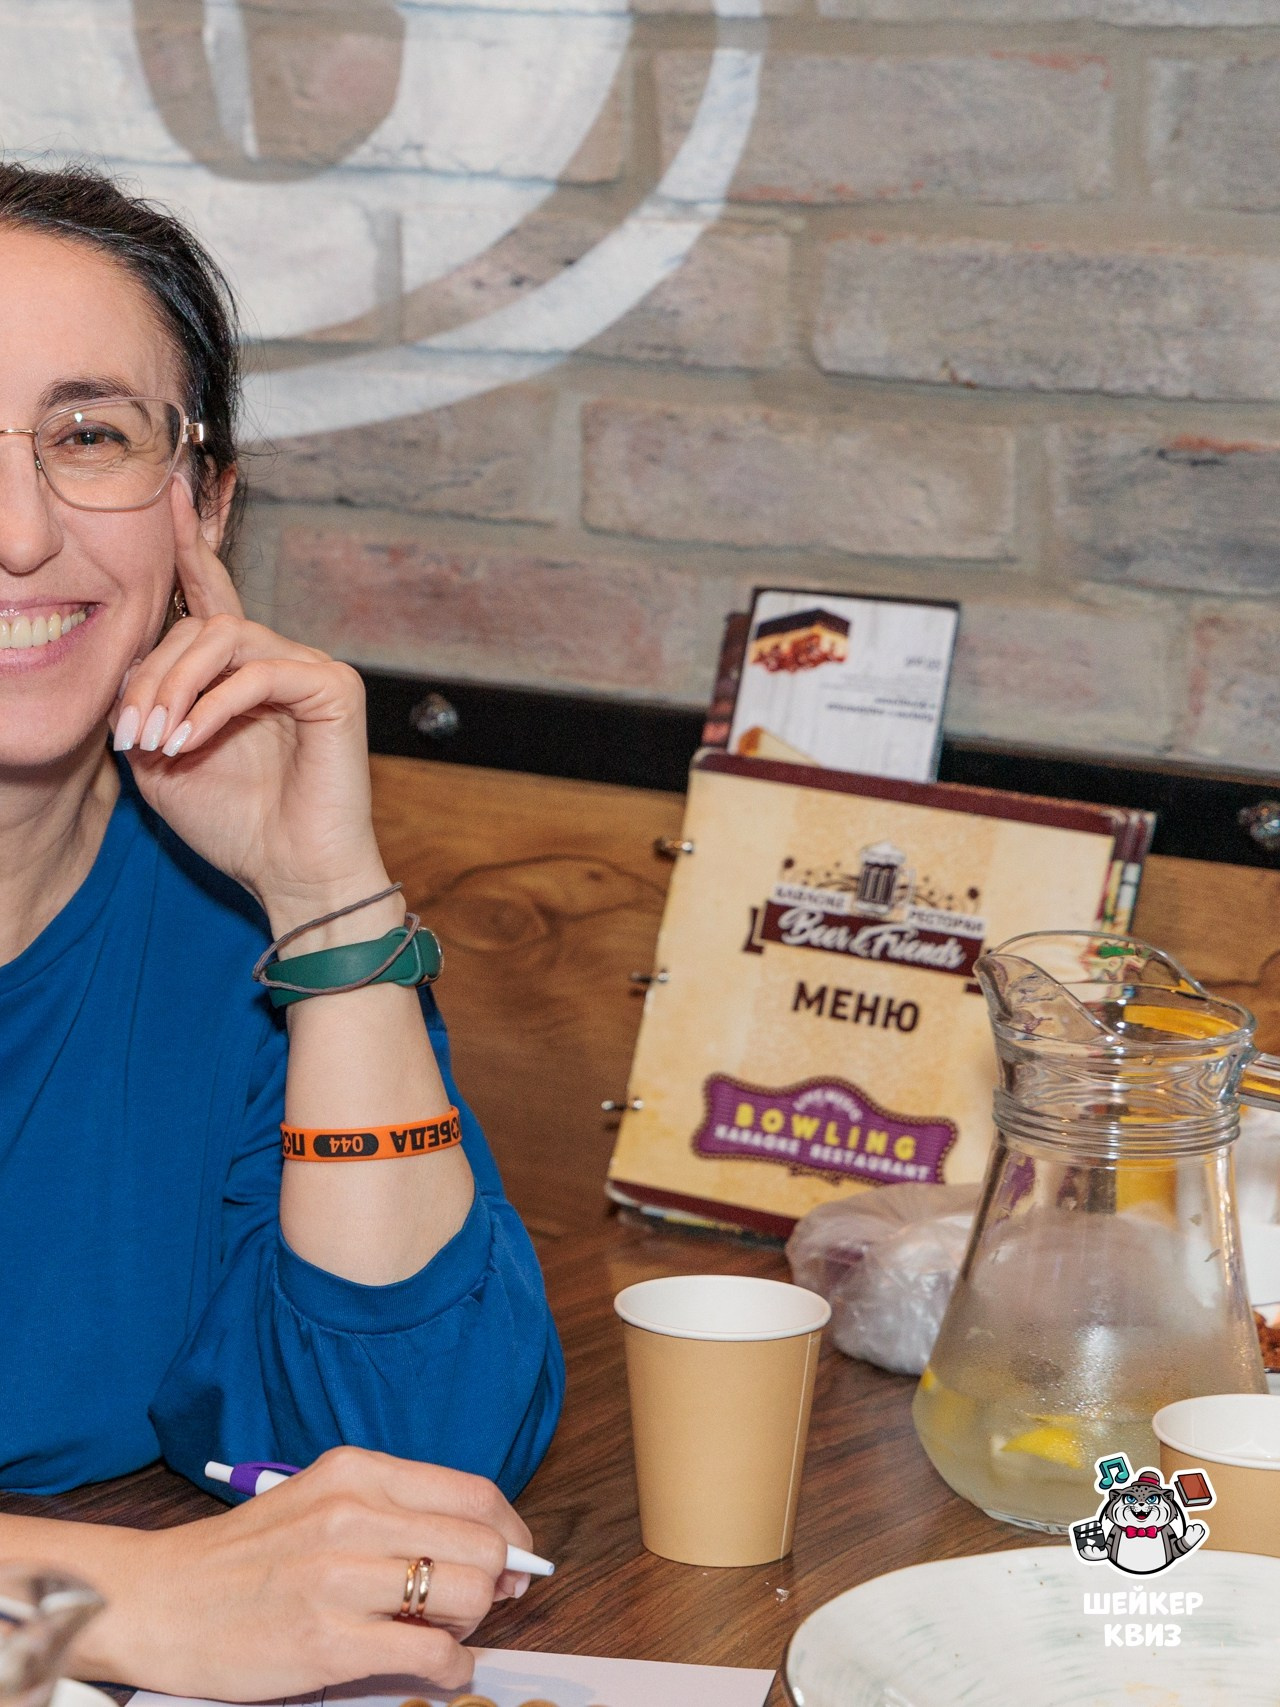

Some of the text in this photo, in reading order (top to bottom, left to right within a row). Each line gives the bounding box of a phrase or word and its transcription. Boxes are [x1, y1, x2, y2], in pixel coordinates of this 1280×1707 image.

[792, 981, 921, 1034] МЕНЮ
[328, 1135, 365, 1154] 044
[389, 1115, 462, 1154] ОБЕДА
[714, 1124, 930, 1181] KARAOKE RESTAURANT
[734, 1101, 917, 1161] BOWLING
